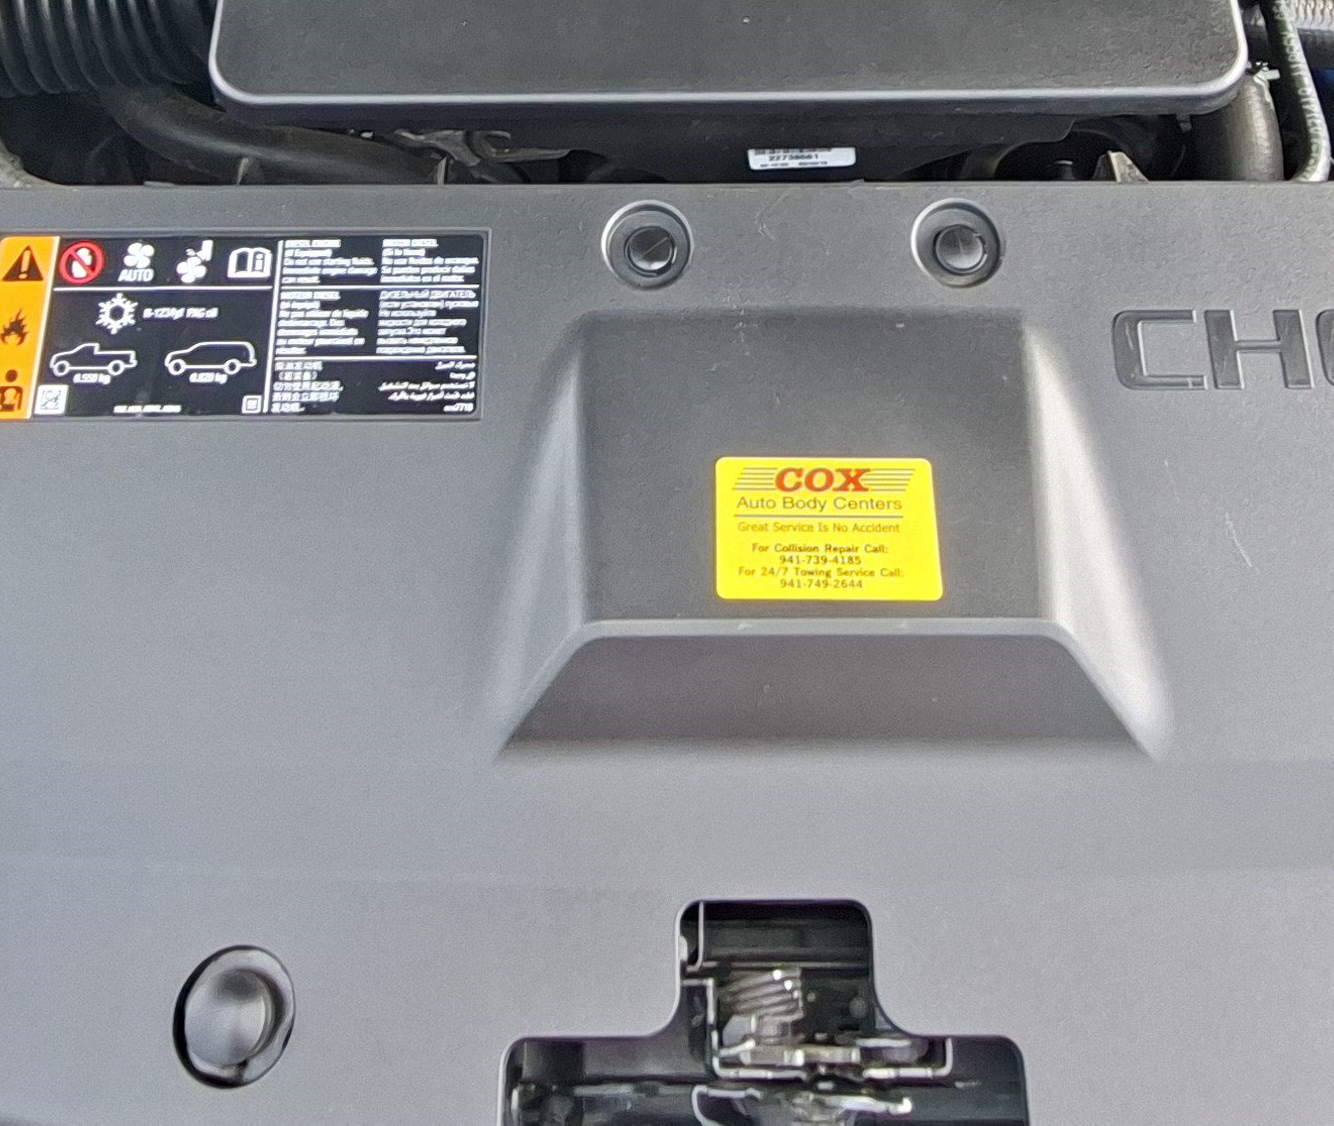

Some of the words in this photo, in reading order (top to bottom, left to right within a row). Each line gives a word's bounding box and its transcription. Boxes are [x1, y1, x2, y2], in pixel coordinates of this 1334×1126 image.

[116, 268, 154, 283] AUTO
[775, 467, 873, 493] COX
[736, 496, 777, 510] Auto
[782, 496, 827, 513] Body
[833, 496, 903, 511] Centers
[738, 522, 769, 532] Great
[773, 522, 814, 532] Service
[818, 523, 829, 533] Is
[833, 523, 848, 533] No
[852, 523, 900, 533] Accident
[752, 543, 769, 552] For
[774, 543, 819, 553] Collision
[825, 544, 859, 555] Repair
[864, 544, 888, 554] Call:
[779, 556, 862, 565] 941-739-4185
[738, 566, 756, 576] For
[761, 567, 788, 577] 24/7
[793, 568, 832, 578] Towing
[836, 568, 875, 578] Service
[880, 568, 904, 577] Call:
[780, 579, 863, 589] 941-749-2644
